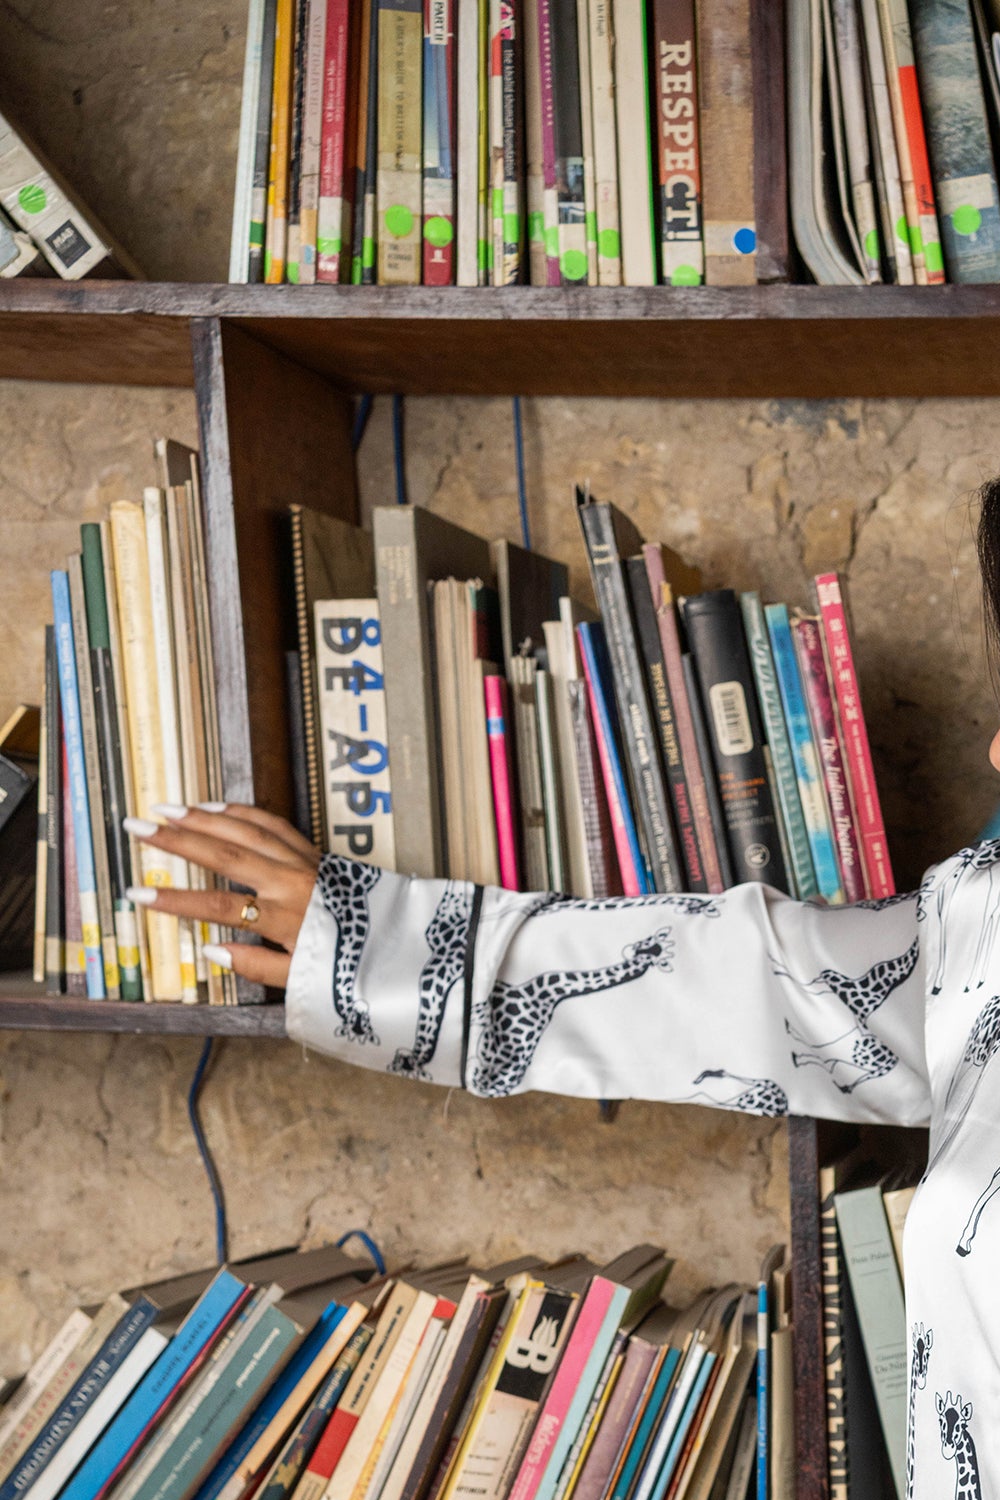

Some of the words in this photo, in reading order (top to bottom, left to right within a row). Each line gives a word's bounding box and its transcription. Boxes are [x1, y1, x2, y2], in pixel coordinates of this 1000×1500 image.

[432, 0, 449, 31] PART
[502, 49, 514, 62] the
[502, 65, 515, 91] khalid
[504, 129, 517, 175] foundation
[659, 39, 703, 242] RESPECT!
[320, 617, 362, 692] DE
[648, 661, 669, 707] PAYSAGE
[342, 617, 391, 816] 84-05
[657, 707, 672, 722] DE
[819, 735, 840, 763] The
[673, 782, 692, 824] THEATRE
[824, 763, 849, 811] Indian
[681, 826, 703, 882] LANDSCAPE
[833, 813, 859, 867] Theatre
[67, 1358, 112, 1409] RUSKIN
[8, 1432, 60, 1492] OXFORD
